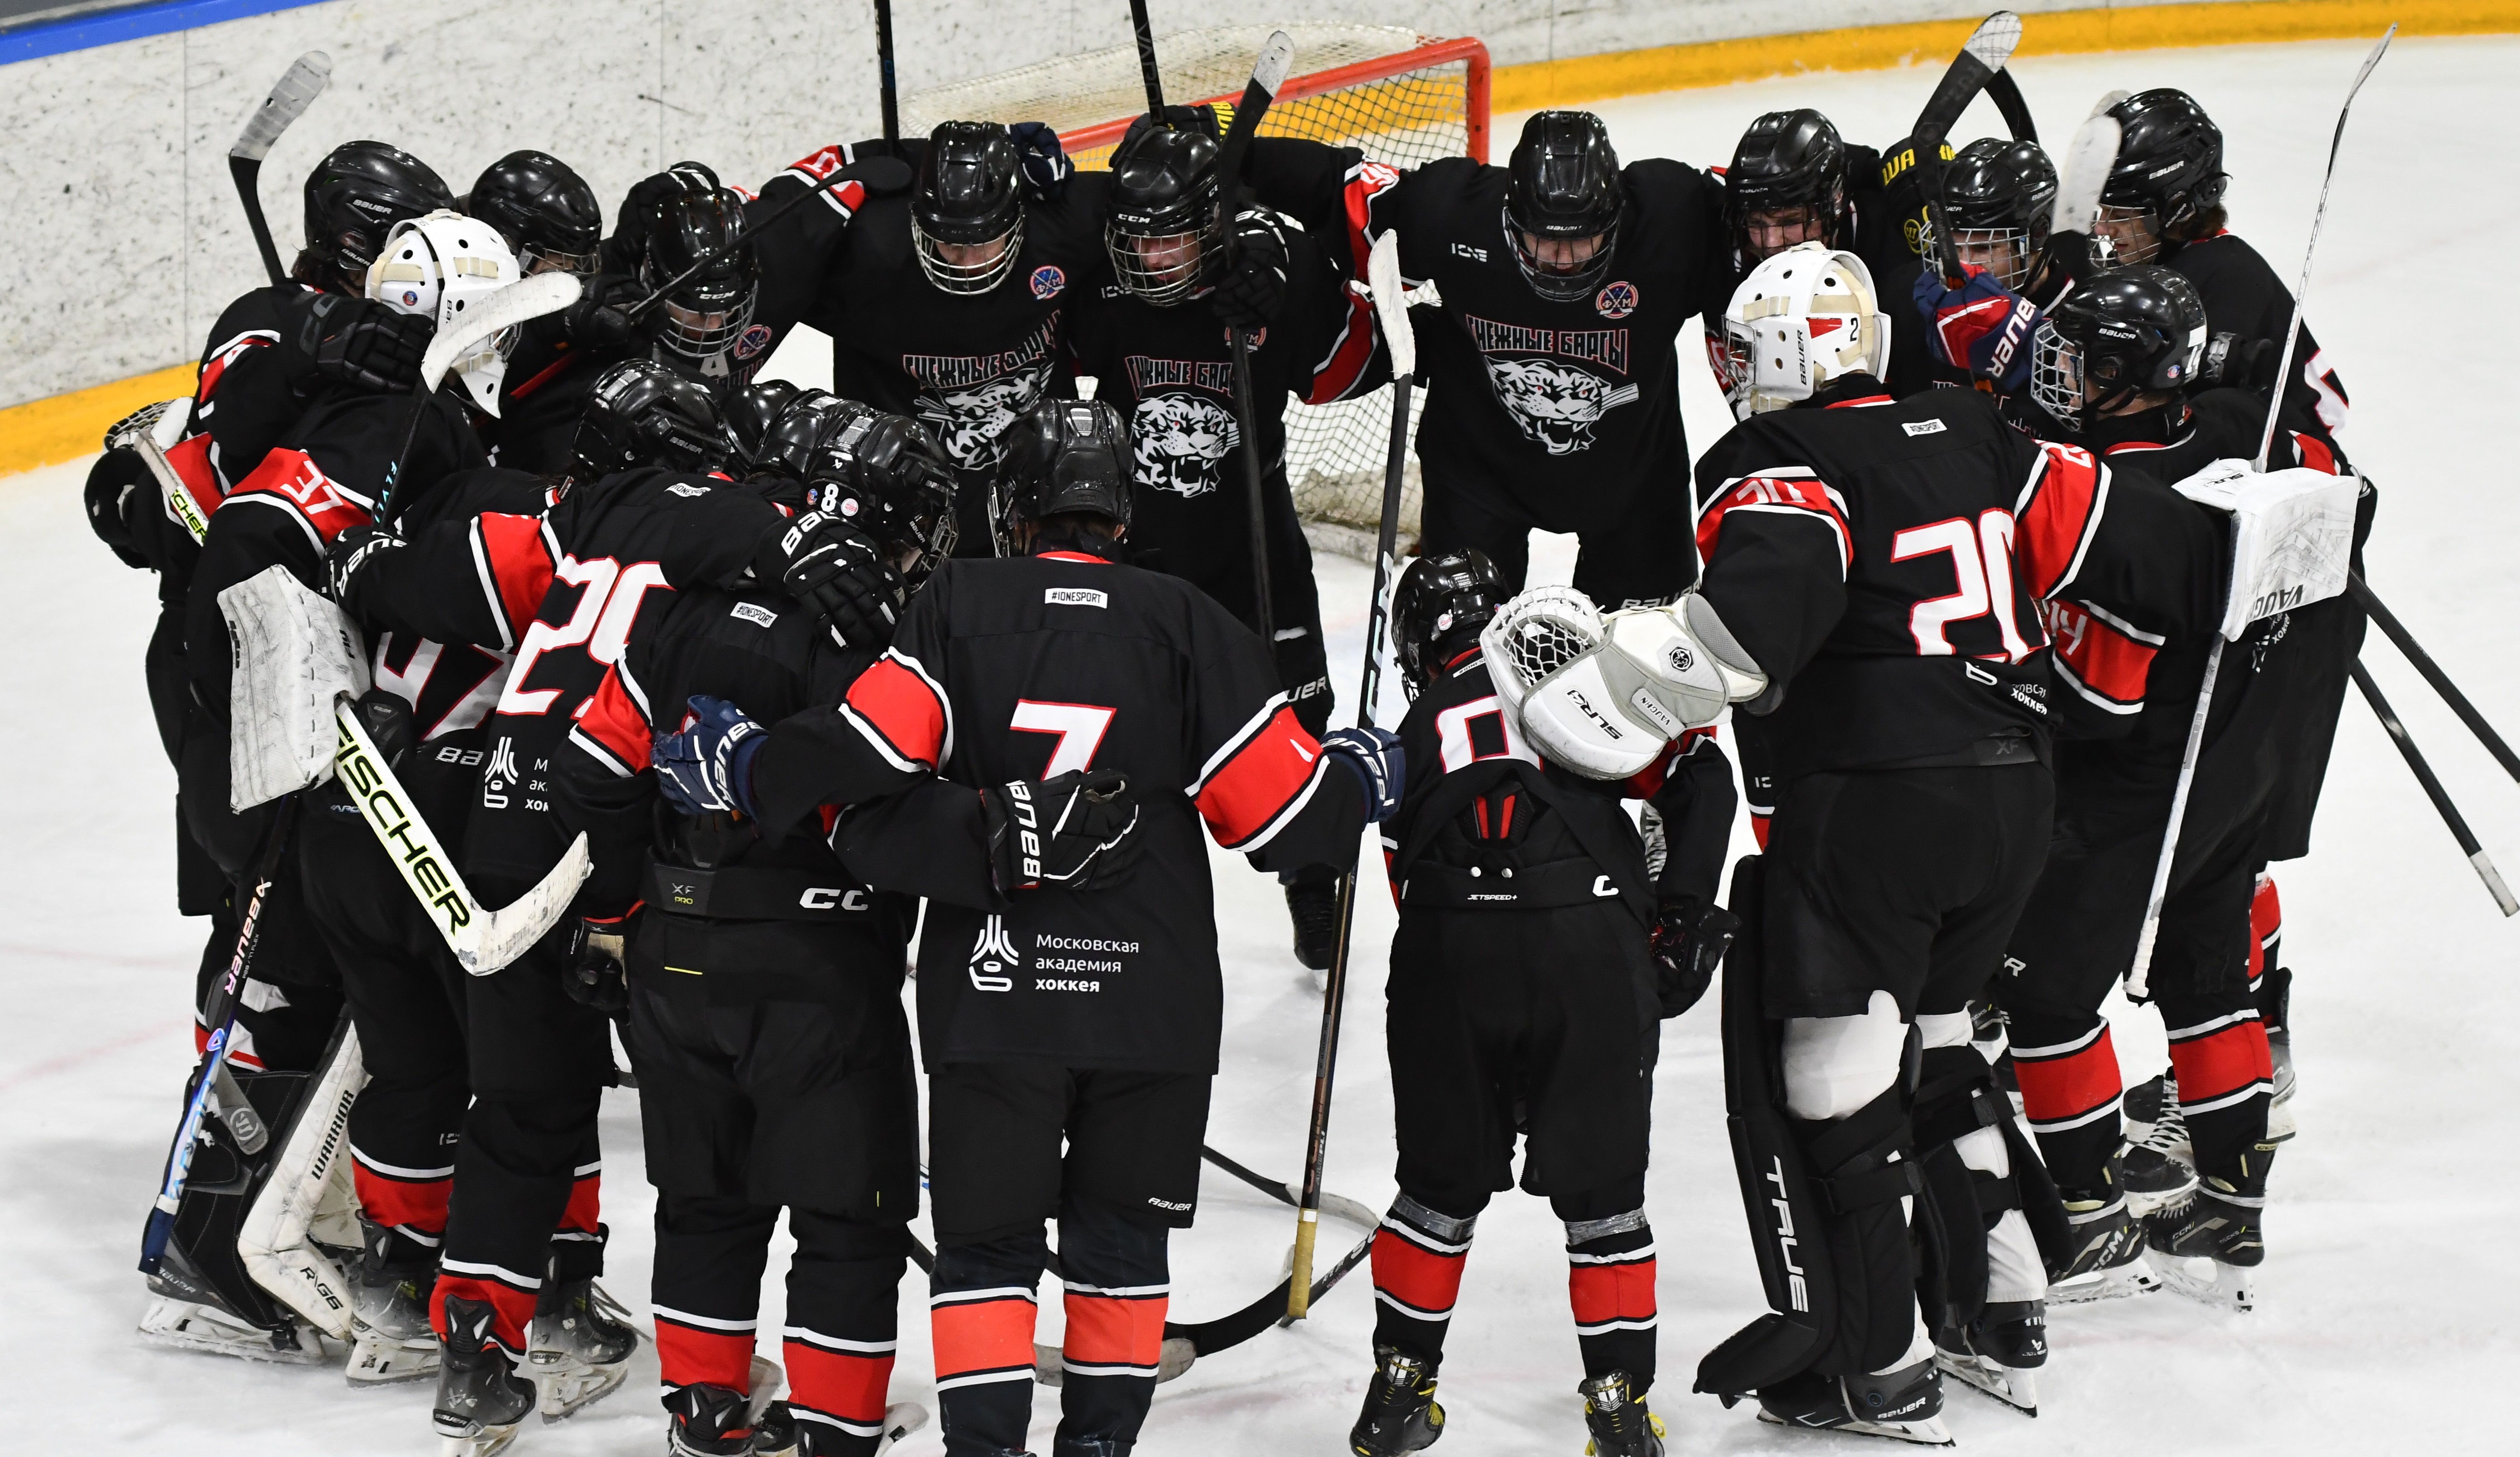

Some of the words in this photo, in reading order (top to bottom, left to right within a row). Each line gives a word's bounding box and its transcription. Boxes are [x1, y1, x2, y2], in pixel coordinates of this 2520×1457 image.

[2149, 160, 2185, 180] BAUER
[2032, 186, 2056, 201] BAUER
[353, 199, 392, 215] BAUER
[1117, 213, 1151, 224] CCM
[699, 290, 736, 300] CCM
[1558, 328, 1628, 375] БАРСЫ
[1797, 329, 1807, 386] BAUER
[700, 352, 730, 377] A
[669, 436, 703, 455] BAUER
[821, 483, 839, 512] 8
[909, 520, 926, 544] BAUER
[1051, 592, 1102, 604] #IONESPORT
[737, 605, 774, 625] #IONESPORT
[1288, 676, 1327, 703] UER
[1640, 697, 1671, 726] VAUGHN
[1009, 698, 1117, 782] 7
[335, 713, 471, 937] FISCHER
[1005, 780, 1041, 879] BAUER
[672, 882, 696, 895] XF
[674, 896, 693, 905] PRO
[799, 887, 869, 911] CC
[224, 896, 262, 996] BAUER
[251, 934, 260, 951] FLEX
[1036, 934, 1139, 954] Московская
[1036, 957, 1122, 974] академия
[1035, 978, 1100, 993] хоккея
[311, 1089, 355, 1181] WARRIOR
[1766, 1155, 1809, 1314] TRUE
[2219, 1231, 2240, 1244] TACKS
[1878, 1396, 1927, 1420] BAUER
[435, 1413, 468, 1426] BAUER
